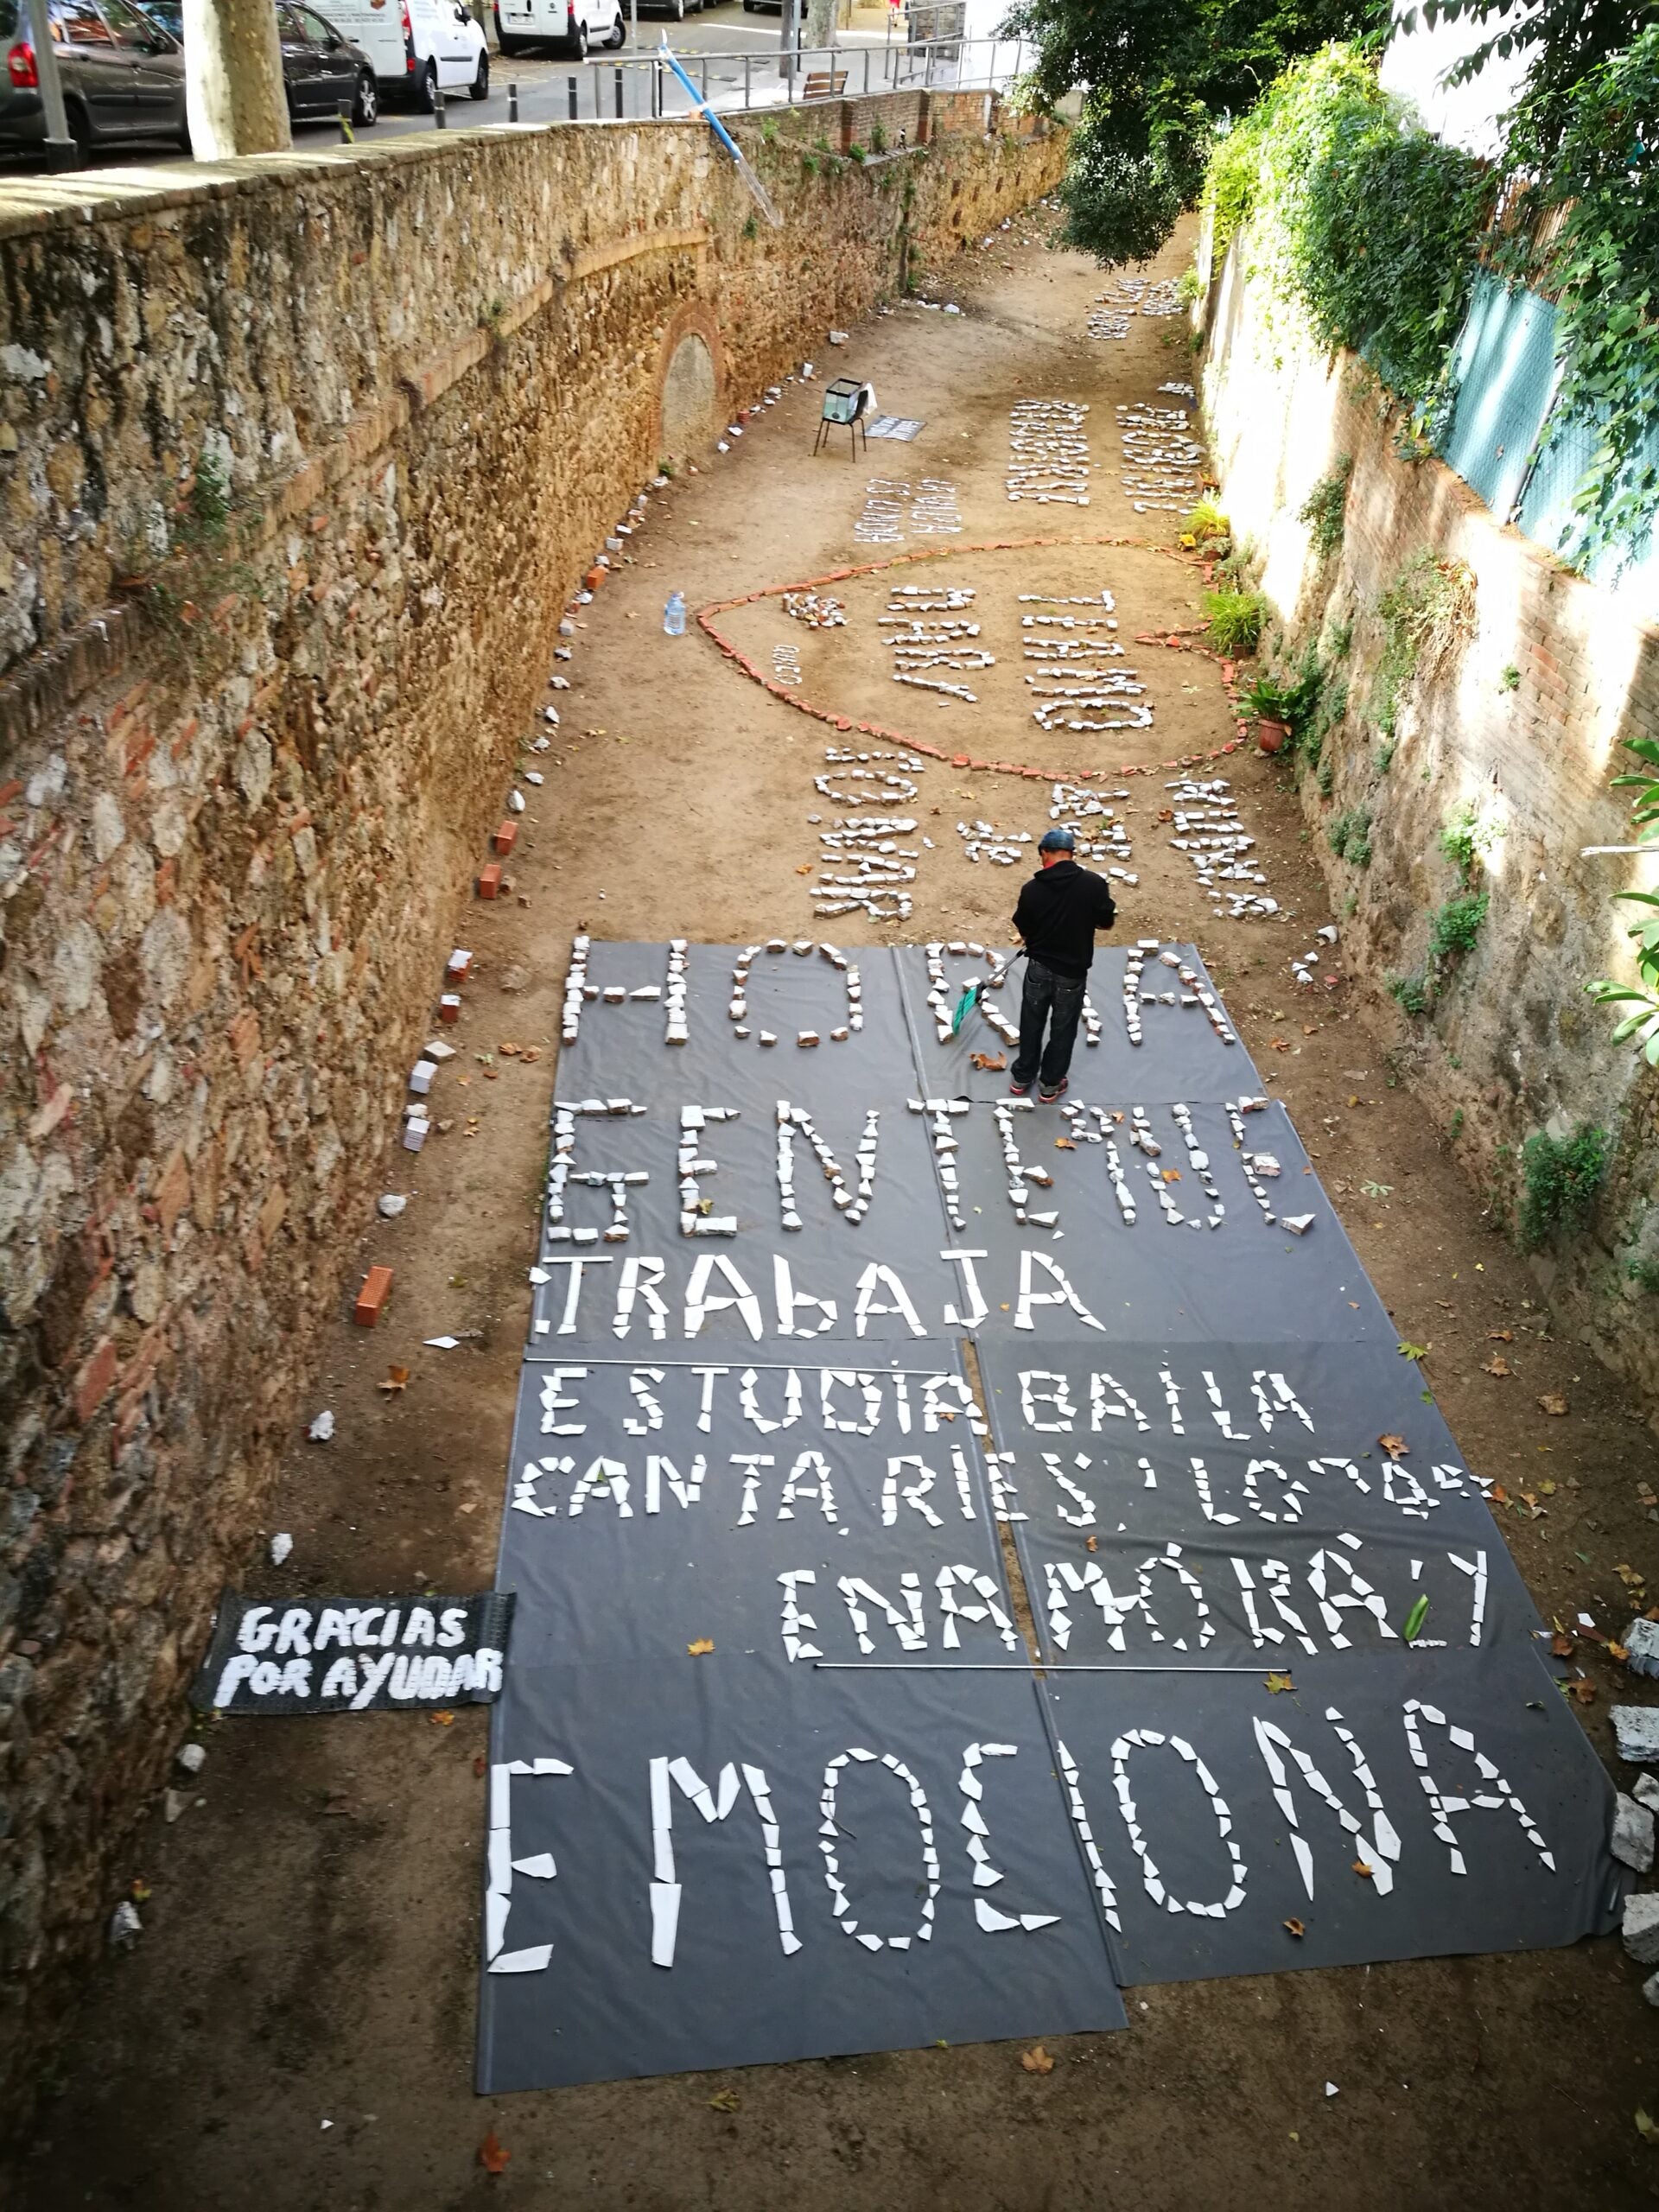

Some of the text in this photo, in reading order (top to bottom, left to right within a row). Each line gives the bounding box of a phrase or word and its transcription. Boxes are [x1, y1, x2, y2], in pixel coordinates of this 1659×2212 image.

[236, 1606, 468, 1656] GRACIAS
[213, 1648, 504, 1710] POR AYUDAR
[486, 1699, 1556, 1974] EMOCIONA
